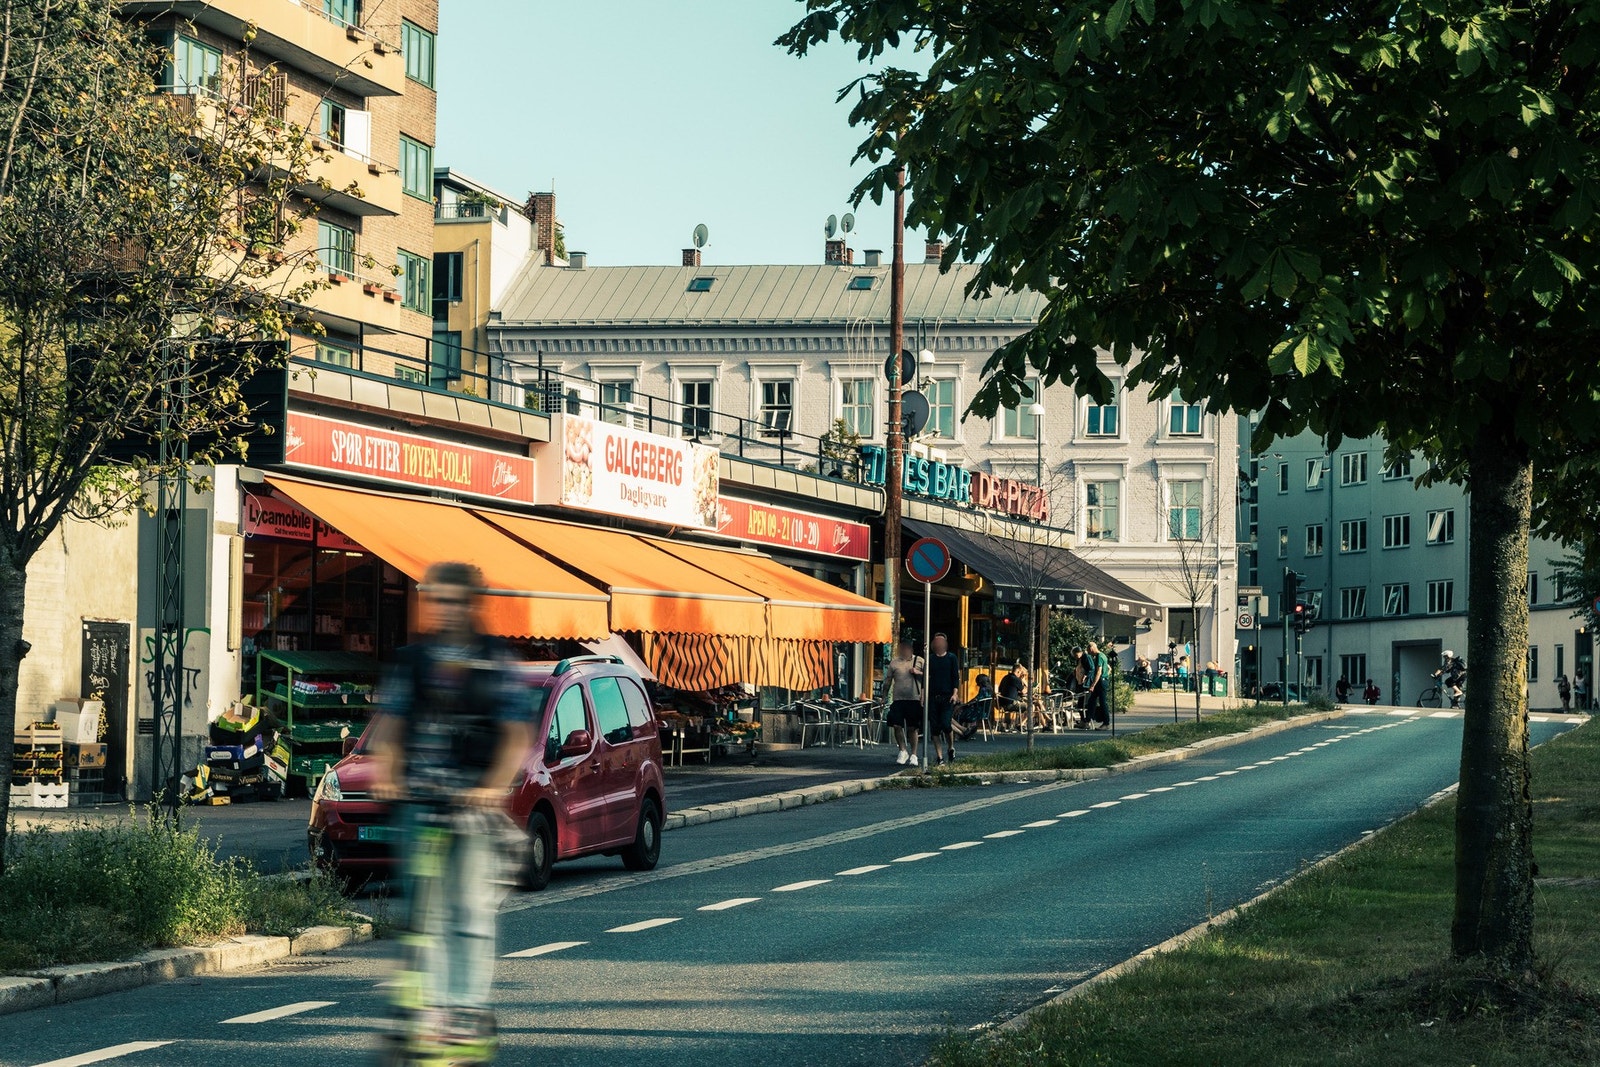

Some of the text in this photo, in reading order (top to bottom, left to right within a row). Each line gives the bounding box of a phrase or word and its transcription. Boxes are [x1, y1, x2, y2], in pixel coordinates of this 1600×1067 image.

[331, 429, 362, 467] SPØR
[365, 435, 401, 473] ETTER
[402, 443, 472, 486] TØYEN-COLA!
[604, 434, 683, 487] GALGEBERG
[619, 482, 668, 510] Dagligvare
[932, 462, 972, 503] BAR
[249, 504, 311, 530] Lycamobile
[747, 505, 767, 536] ÅPEN
[767, 514, 777, 538] 09
[781, 517, 790, 541] 21
[791, 517, 803, 545] (10
[808, 521, 820, 549] 20)
